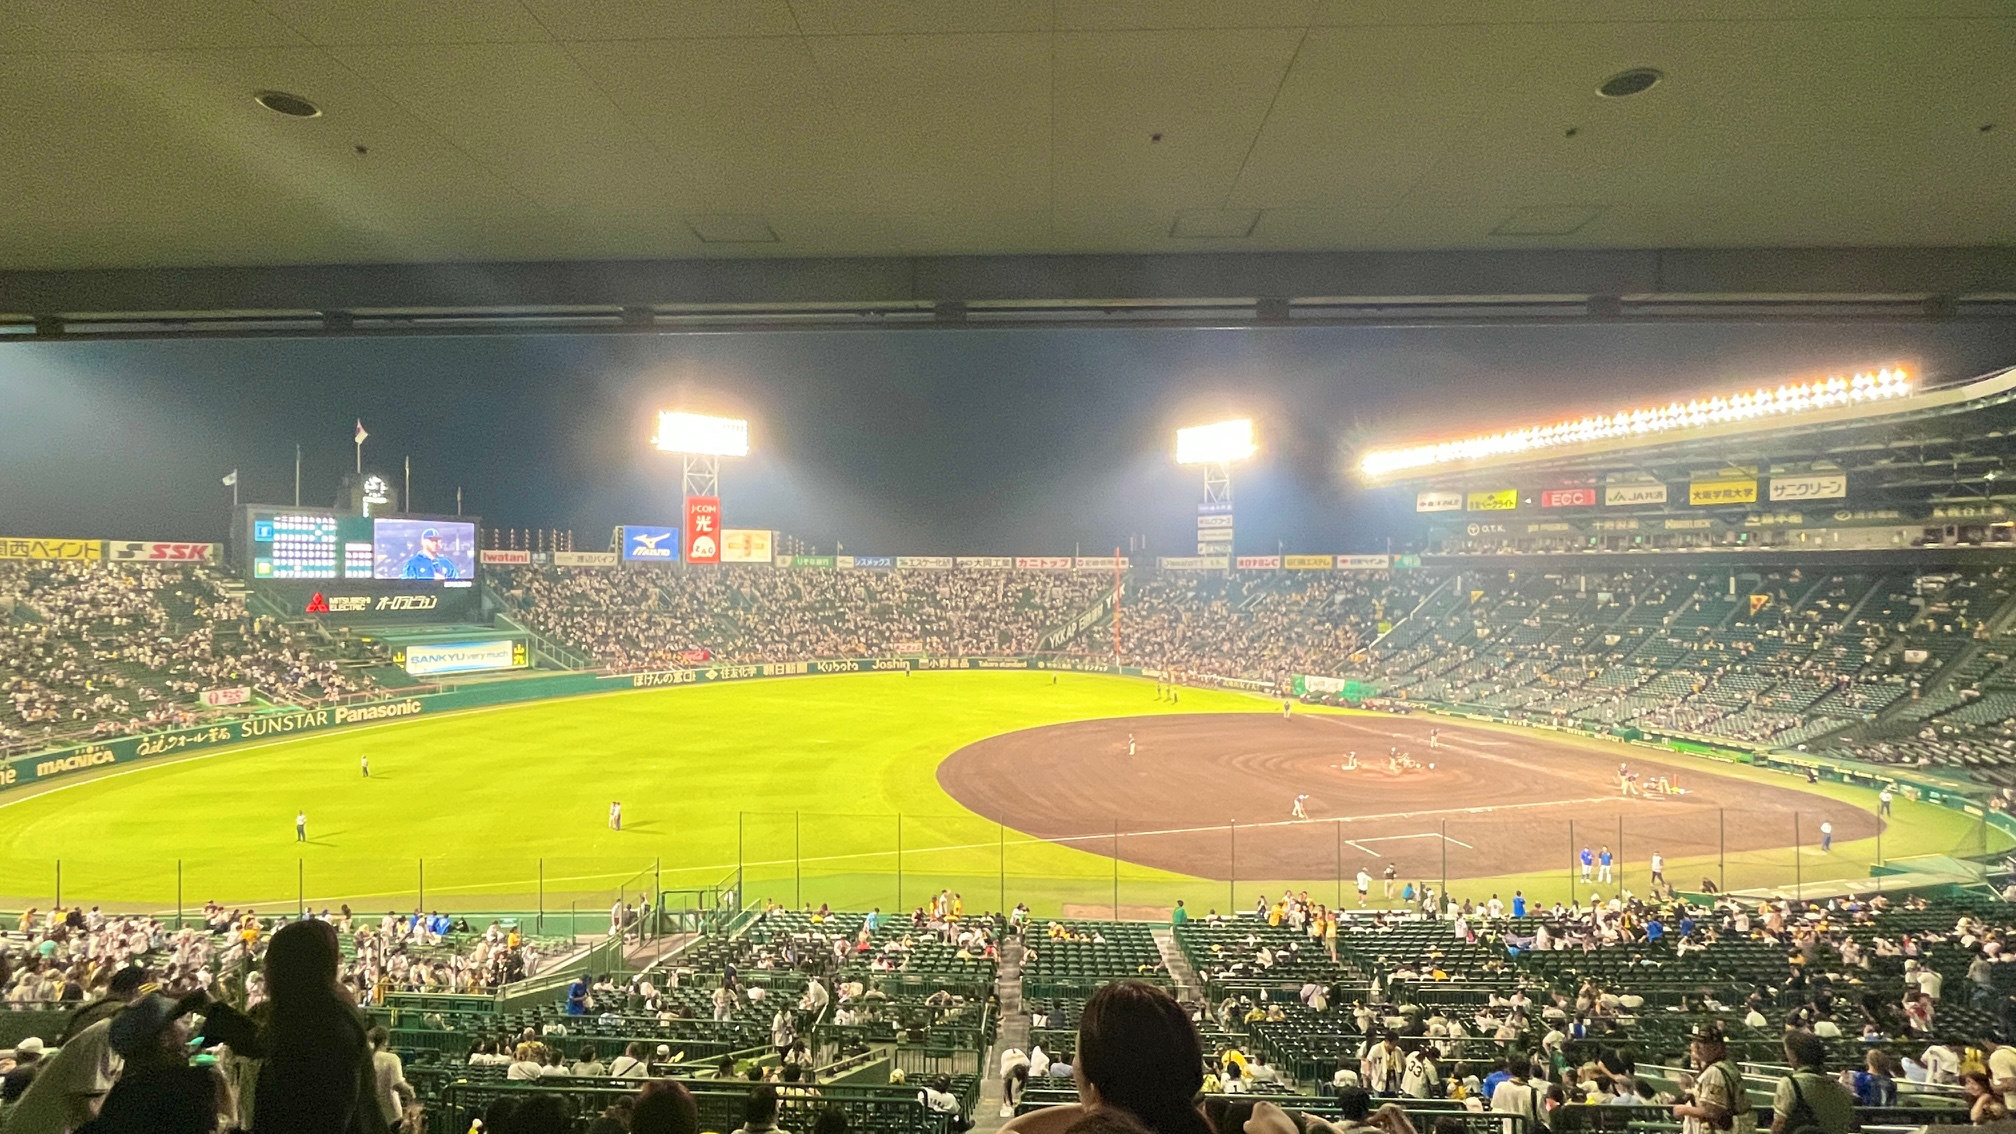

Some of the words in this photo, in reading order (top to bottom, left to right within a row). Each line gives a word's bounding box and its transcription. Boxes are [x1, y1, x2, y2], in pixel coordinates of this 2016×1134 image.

[1692, 488, 1754, 501] 大阪学院大学
[1772, 481, 1843, 497] サニクリーン
[1551, 493, 1584, 506] ECC
[695, 515, 713, 532] 光
[149, 543, 209, 560] SSK
[483, 551, 528, 563] Iwatani
[632, 546, 671, 556] MIZUNO
[1018, 558, 1069, 568] カニトップ
[329, 596, 371, 605] MITSUBISHI
[329, 604, 366, 612] ELECTRIC
[410, 652, 466, 665] SANKYU
[466, 651, 486, 661] very
[871, 658, 911, 670] Joshin
[720, 665, 757, 680] 住友化学
[763, 663, 808, 676] 朝日新聞
[817, 660, 859, 673] Kubota
[633, 670, 692, 687] ほけんの窓口
[335, 698, 422, 724] Panasonic
[240, 710, 328, 738] SUNSTAR
[1408, 1060, 1423, 1078] 33
